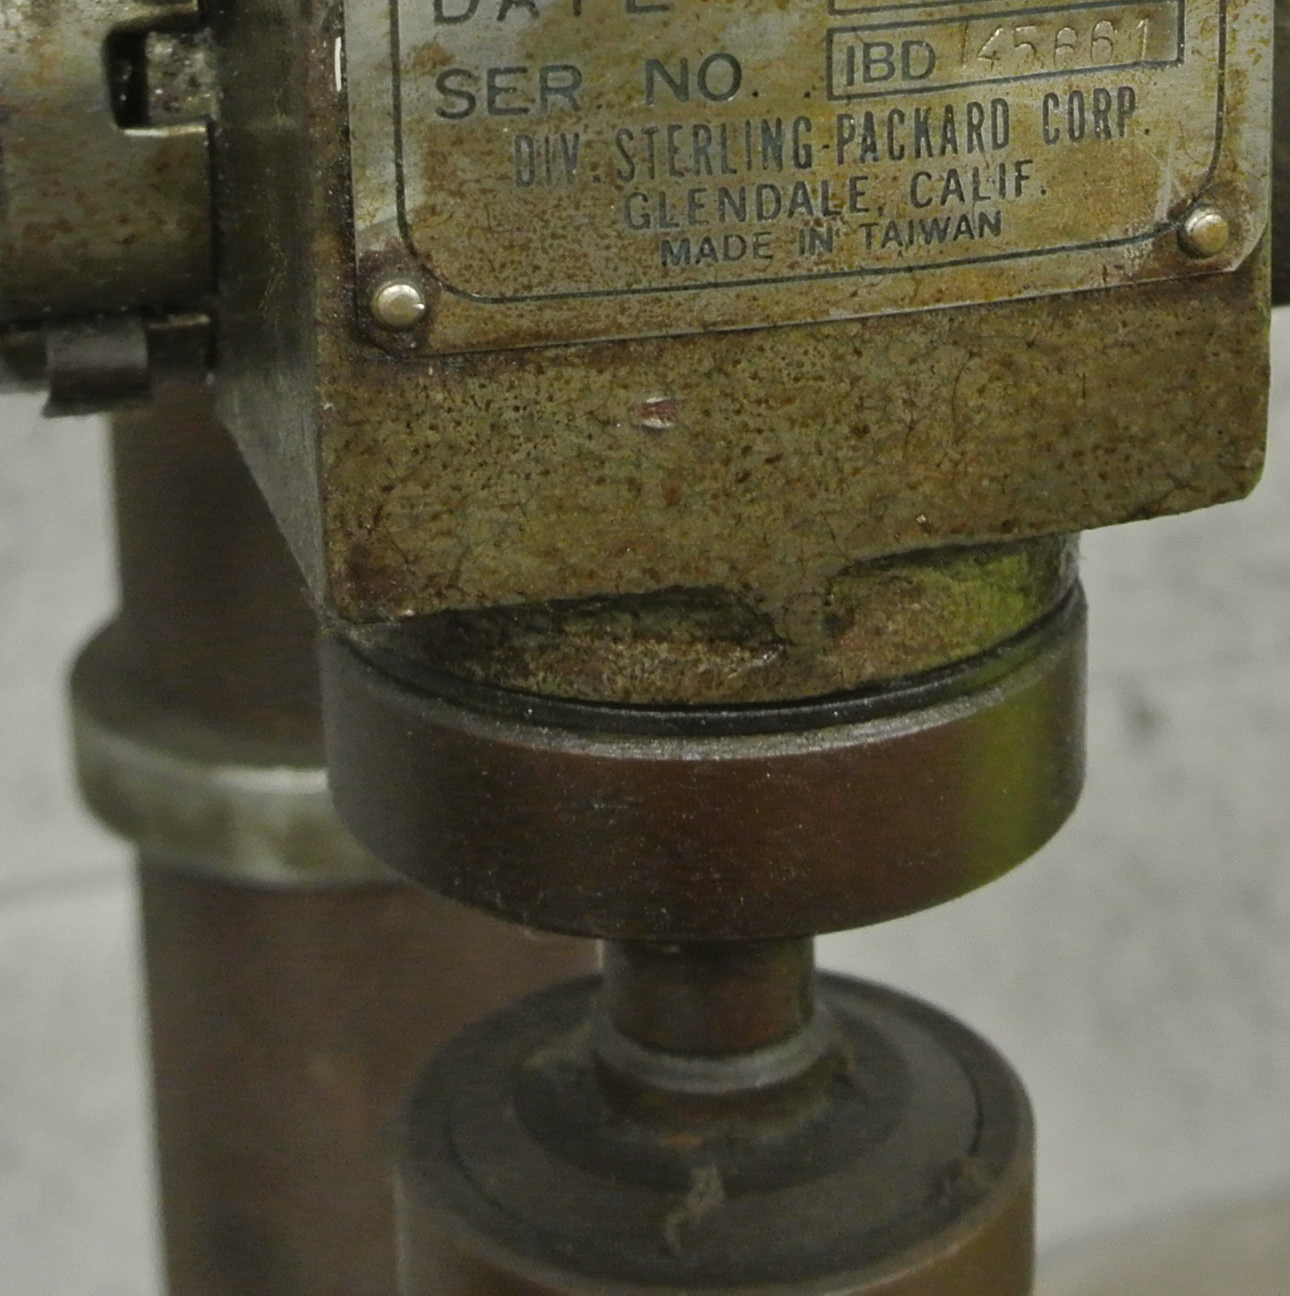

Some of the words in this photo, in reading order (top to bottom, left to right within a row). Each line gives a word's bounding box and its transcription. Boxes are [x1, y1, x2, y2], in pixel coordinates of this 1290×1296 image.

[846, 40, 937, 87] IBD
[1042, 86, 1151, 146] CORP.
[910, 160, 1048, 208] CALIF.
[660, 231, 774, 268] MADE
[799, 226, 834, 256] IN
[859, 210, 1002, 252] TAIWAN
